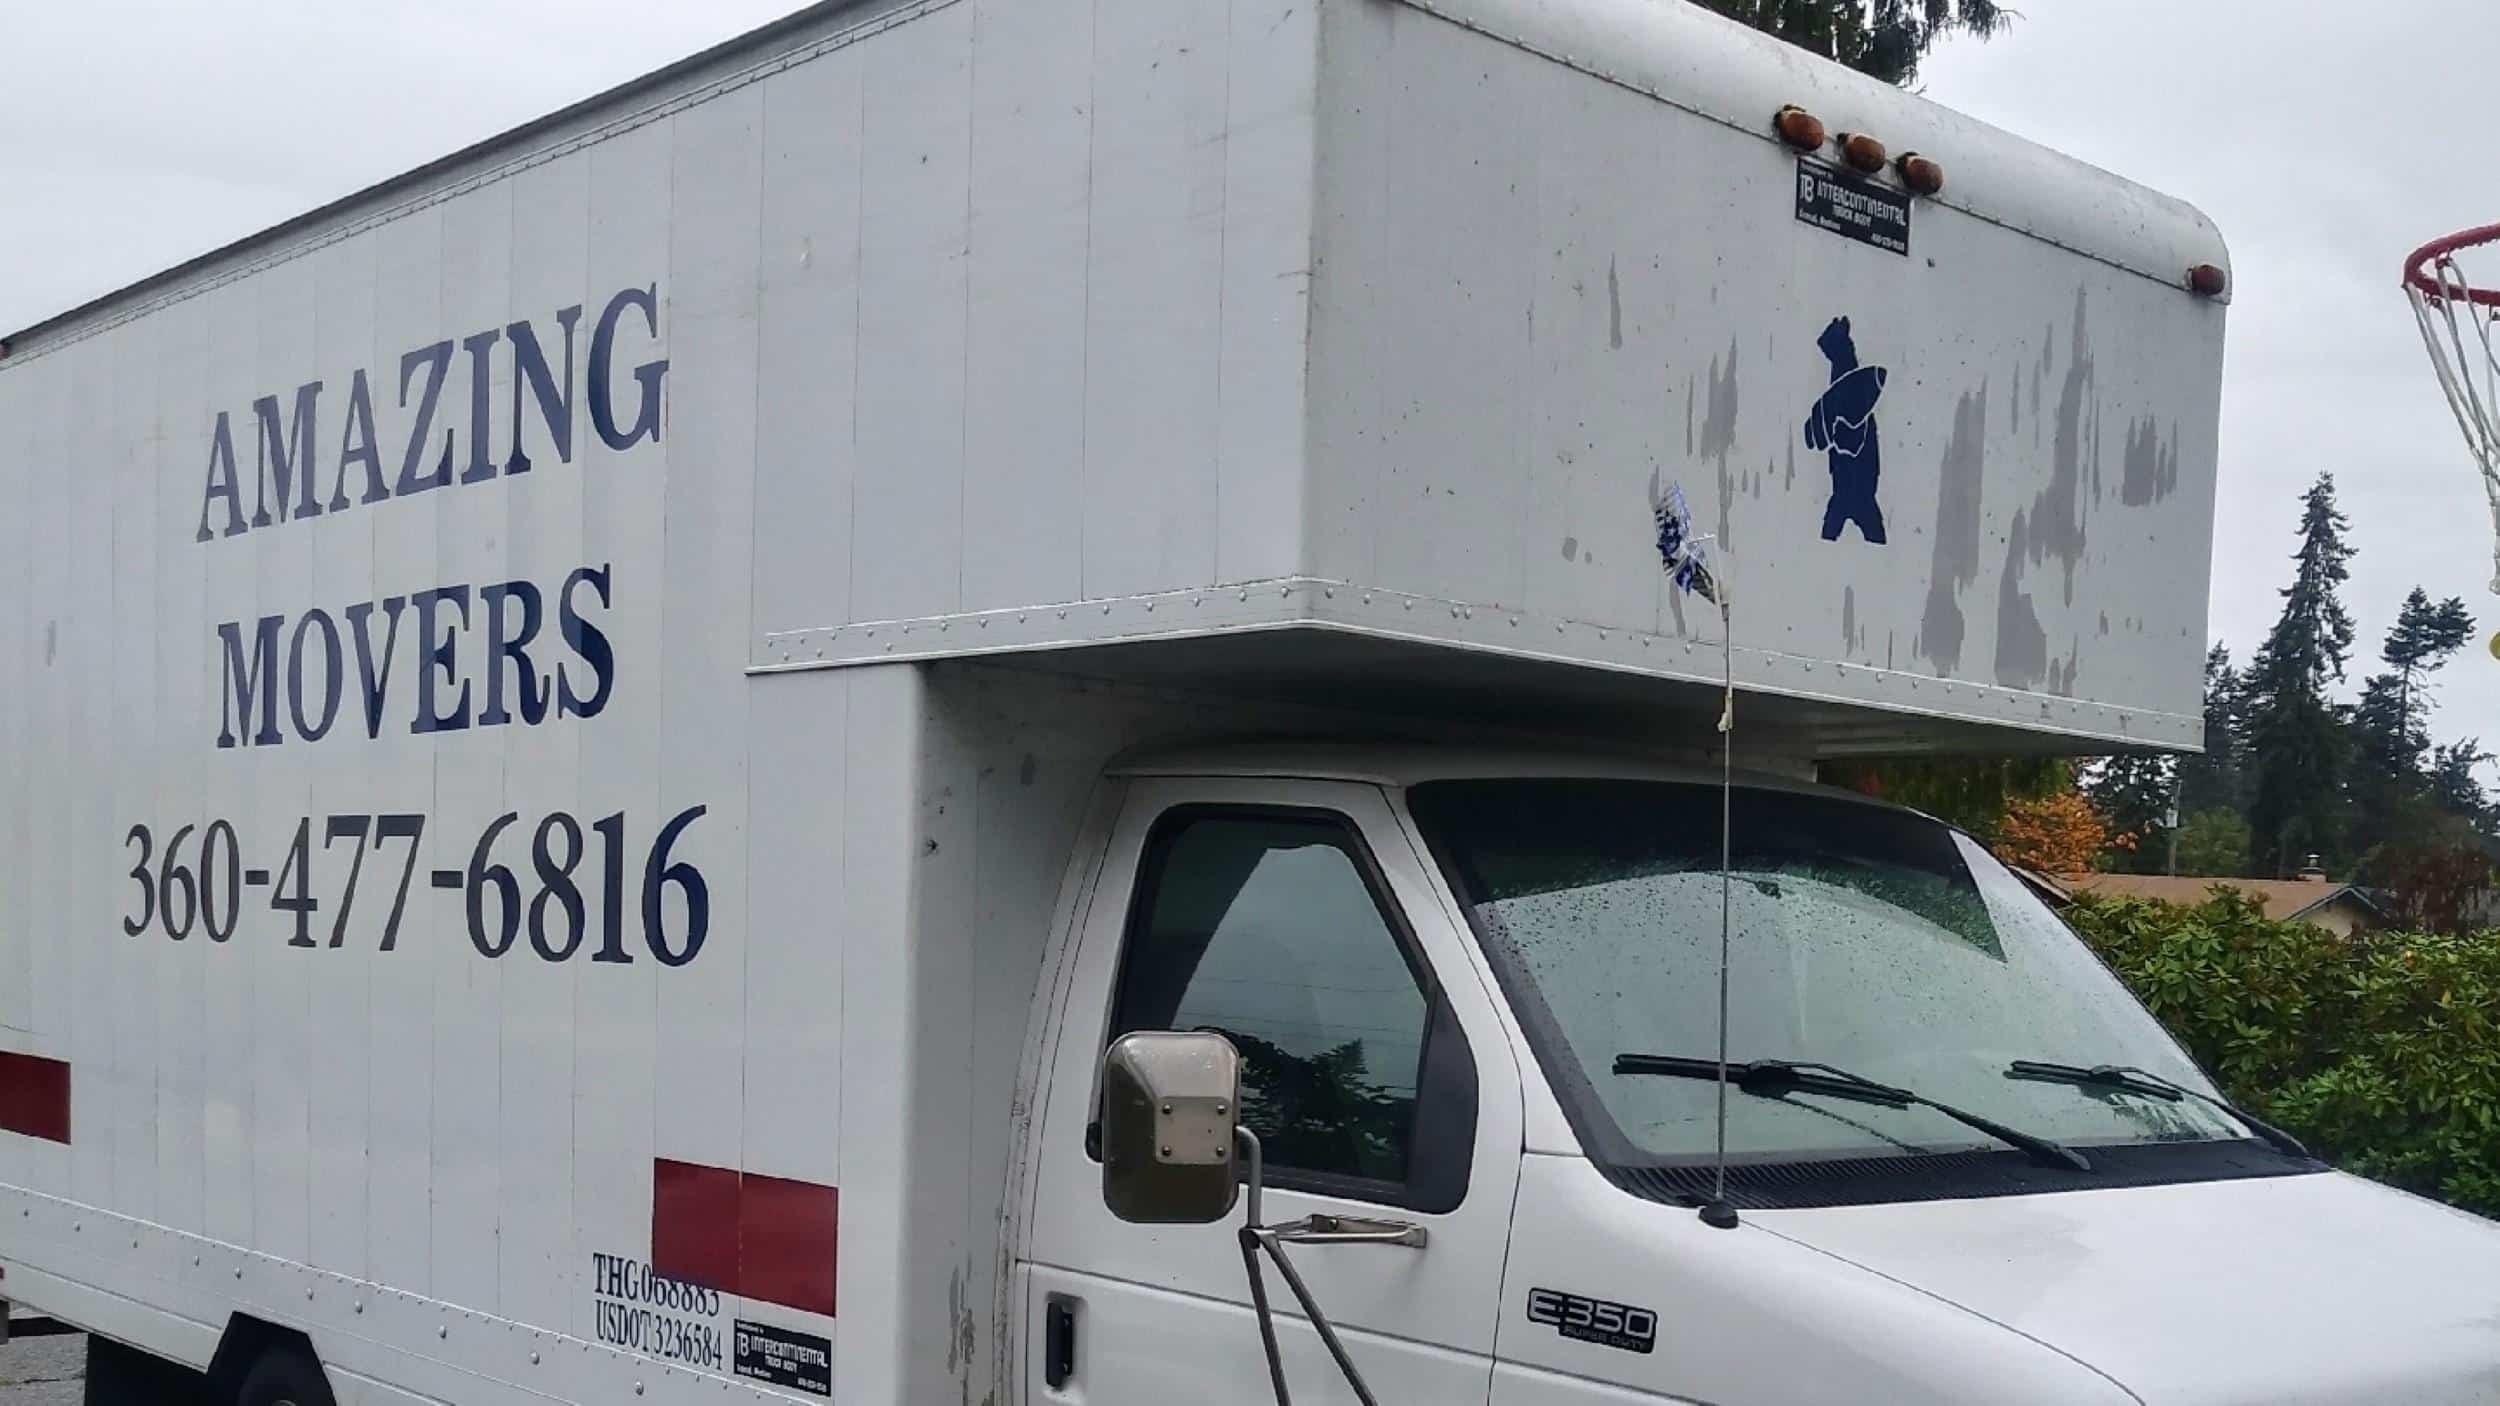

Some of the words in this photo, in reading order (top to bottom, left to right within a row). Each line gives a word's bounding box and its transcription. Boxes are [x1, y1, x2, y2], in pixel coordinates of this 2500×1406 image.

[196, 282, 670, 543] AMAZING
[216, 562, 615, 749] MOVERS
[123, 804, 710, 968] 360-477-6816
